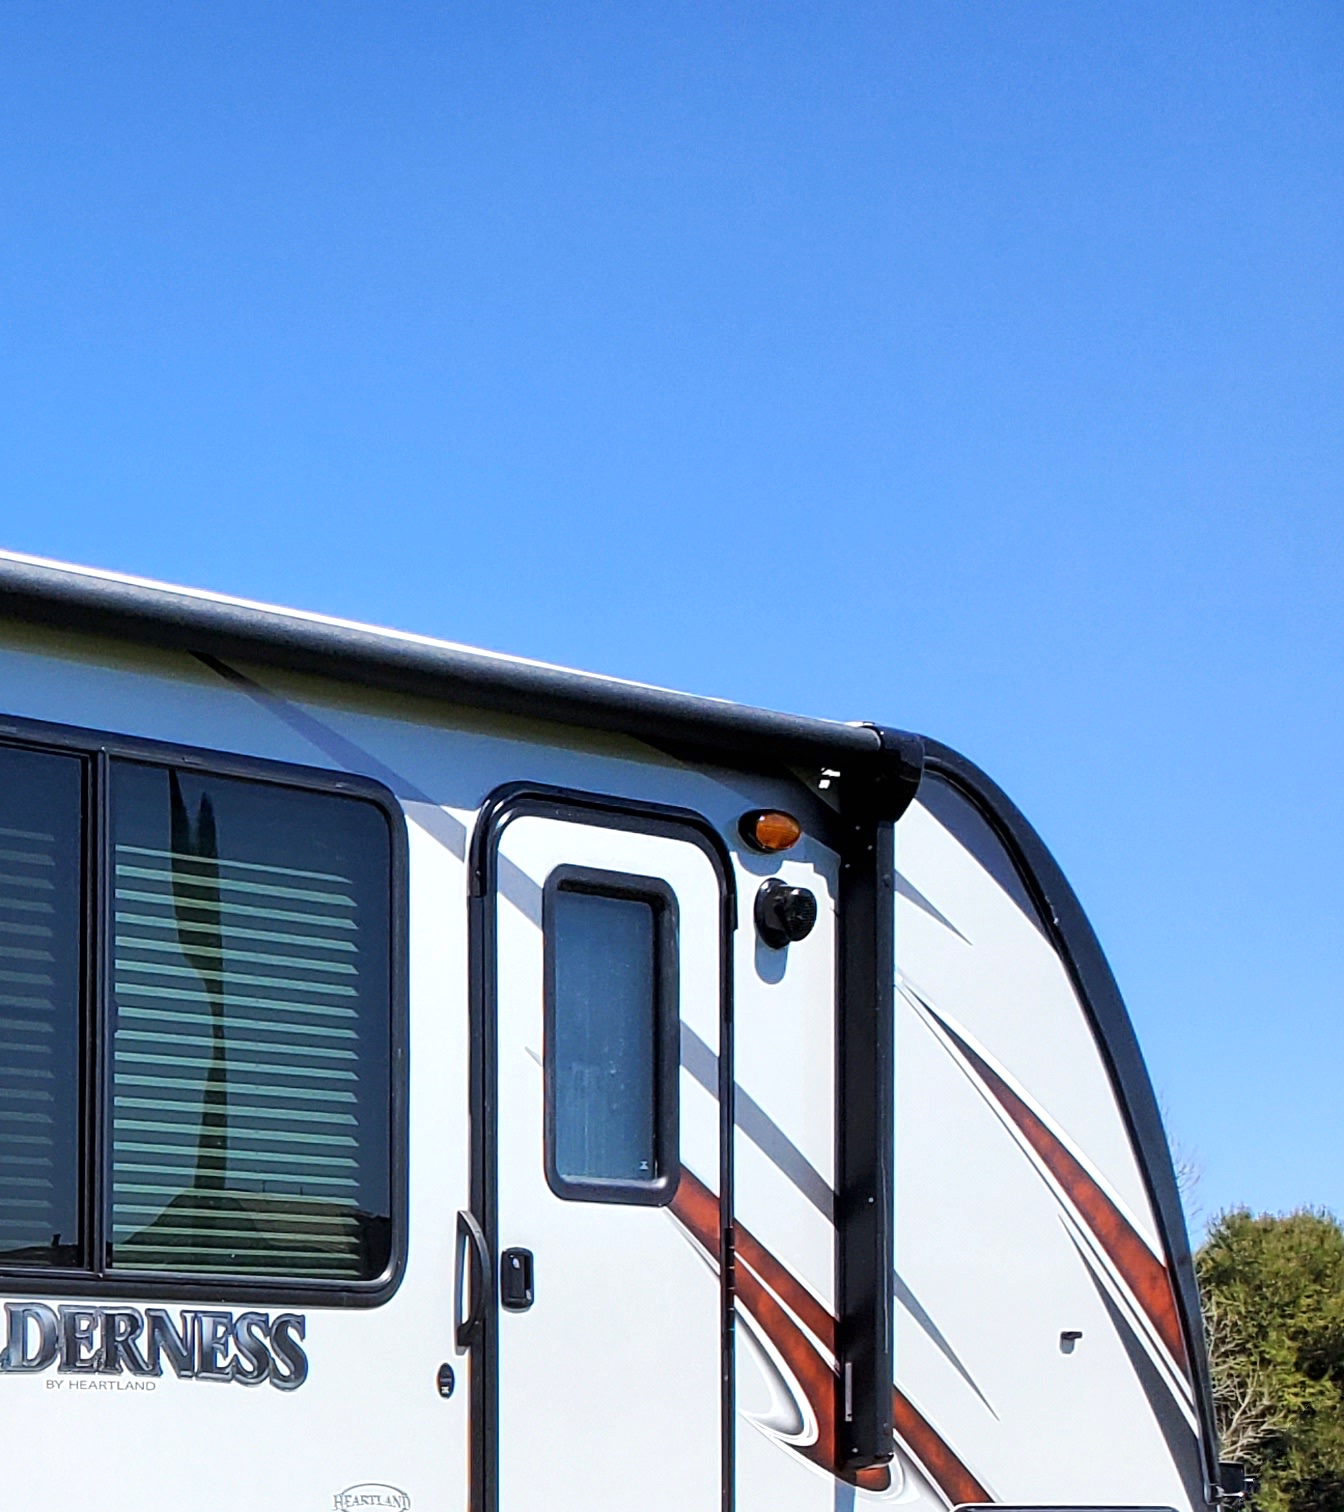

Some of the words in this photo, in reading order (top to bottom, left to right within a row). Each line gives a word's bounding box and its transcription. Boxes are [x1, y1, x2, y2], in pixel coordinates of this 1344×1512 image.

[45, 1379, 65, 1391] BY
[68, 1379, 157, 1392] HEARTLAND
[331, 1493, 411, 1511] HEARTLAND
